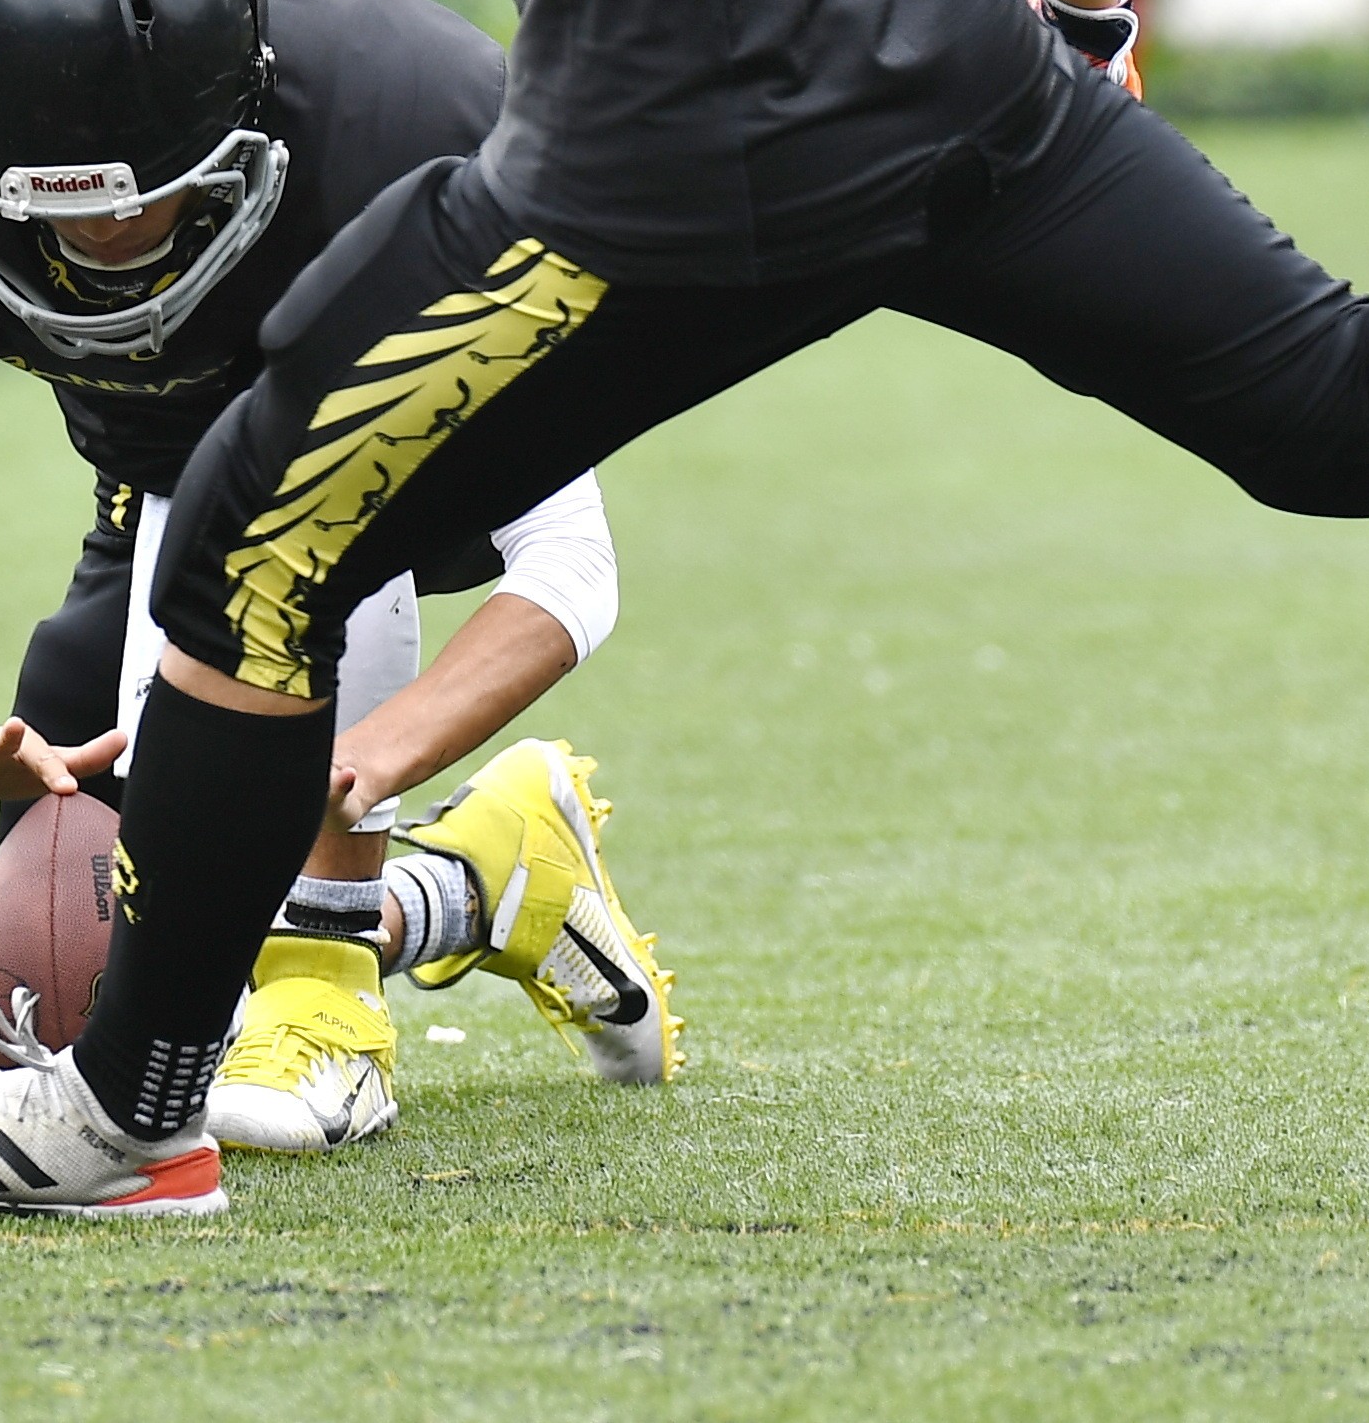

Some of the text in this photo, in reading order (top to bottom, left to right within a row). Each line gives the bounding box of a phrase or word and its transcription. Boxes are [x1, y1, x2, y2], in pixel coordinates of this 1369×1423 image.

[29, 172, 105, 193] Riddell
[92, 854, 111, 922] Wilson
[312, 1011, 358, 1039] ALPHA
